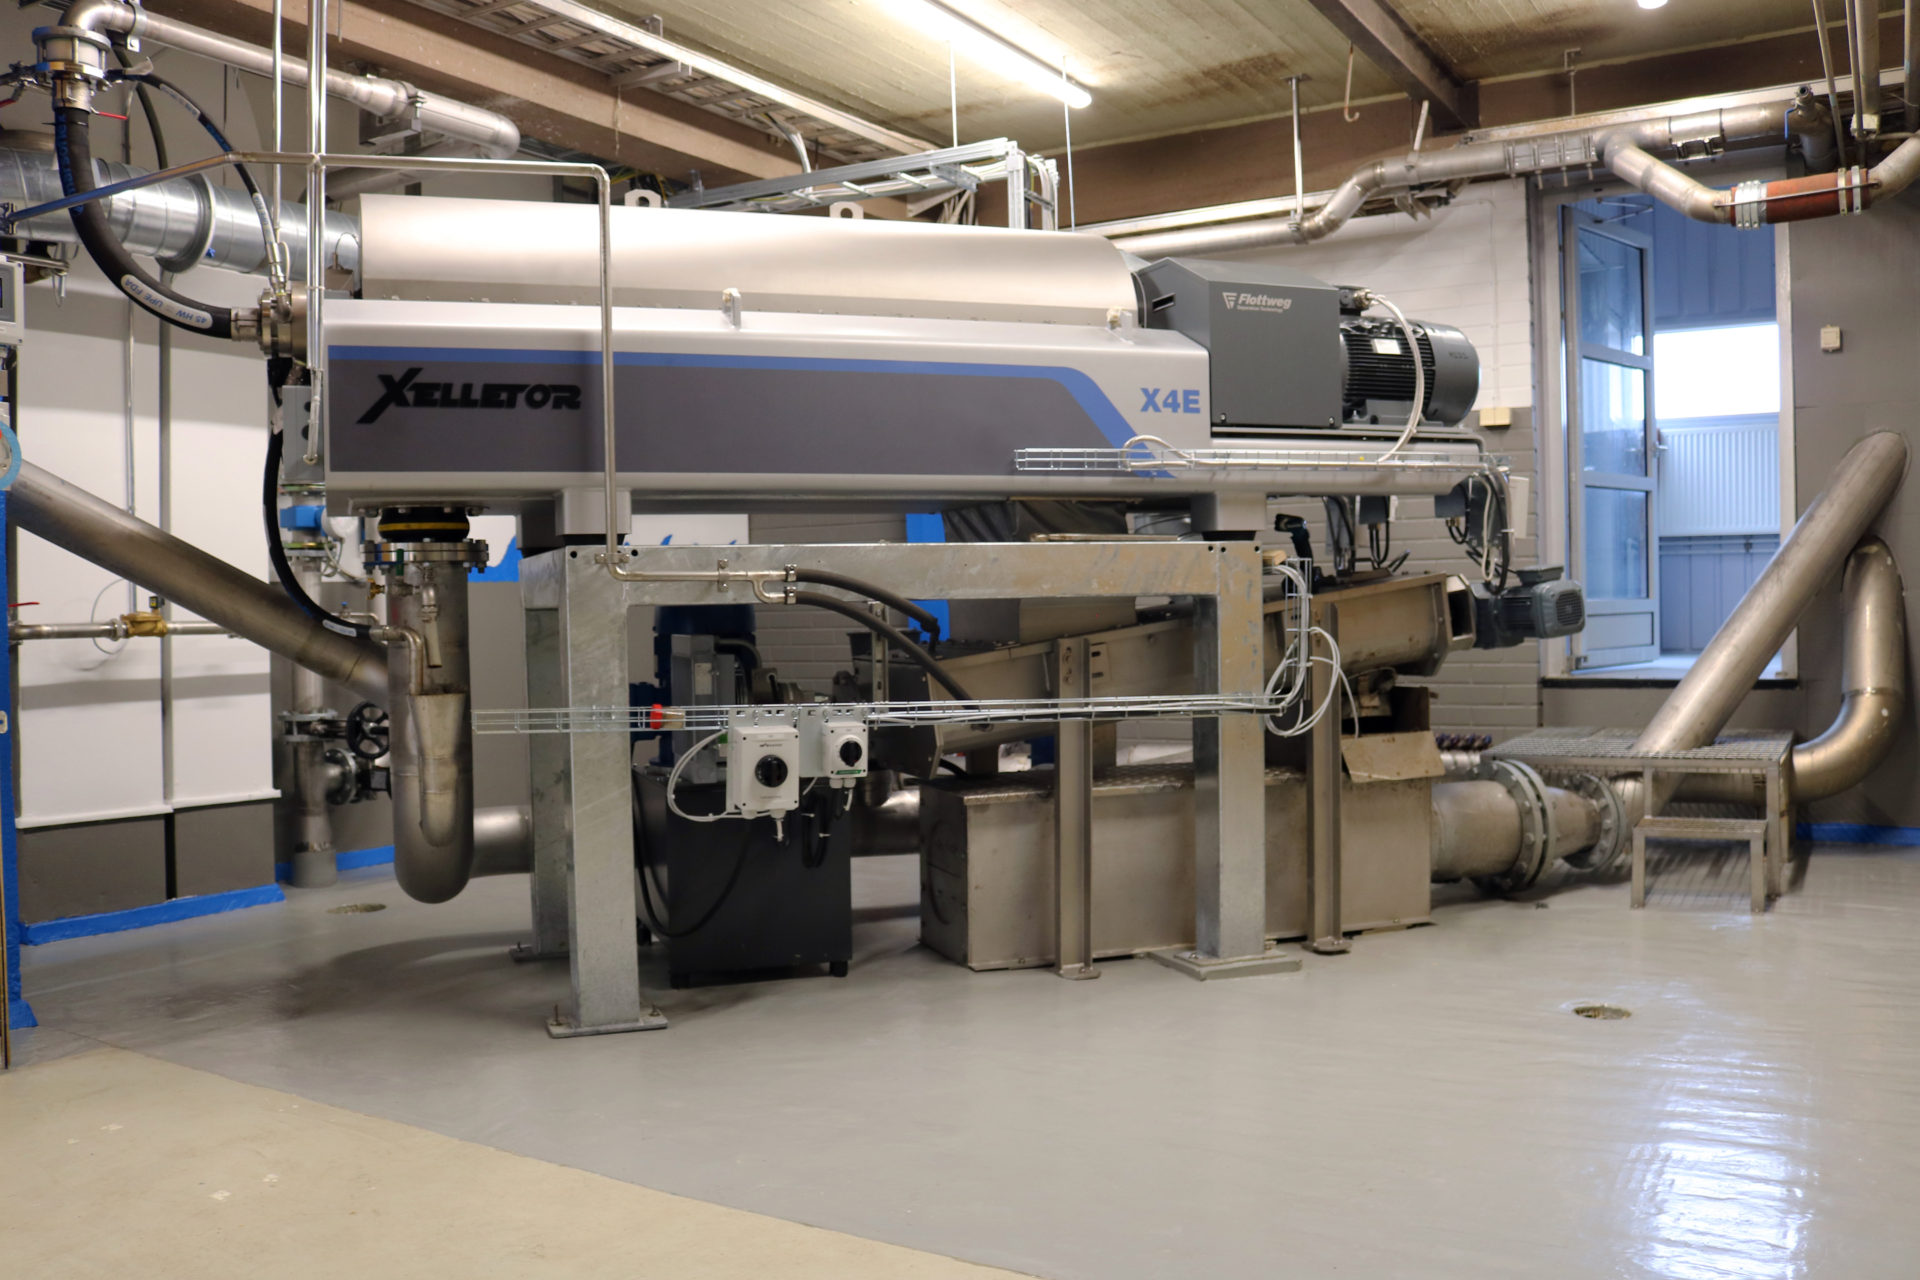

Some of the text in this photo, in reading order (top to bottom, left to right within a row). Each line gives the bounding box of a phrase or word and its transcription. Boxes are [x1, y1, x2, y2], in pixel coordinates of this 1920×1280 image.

[1238, 293, 1292, 310] Flottweg
[355, 367, 582, 425] XELLETOR
[1140, 388, 1201, 414] X4E
